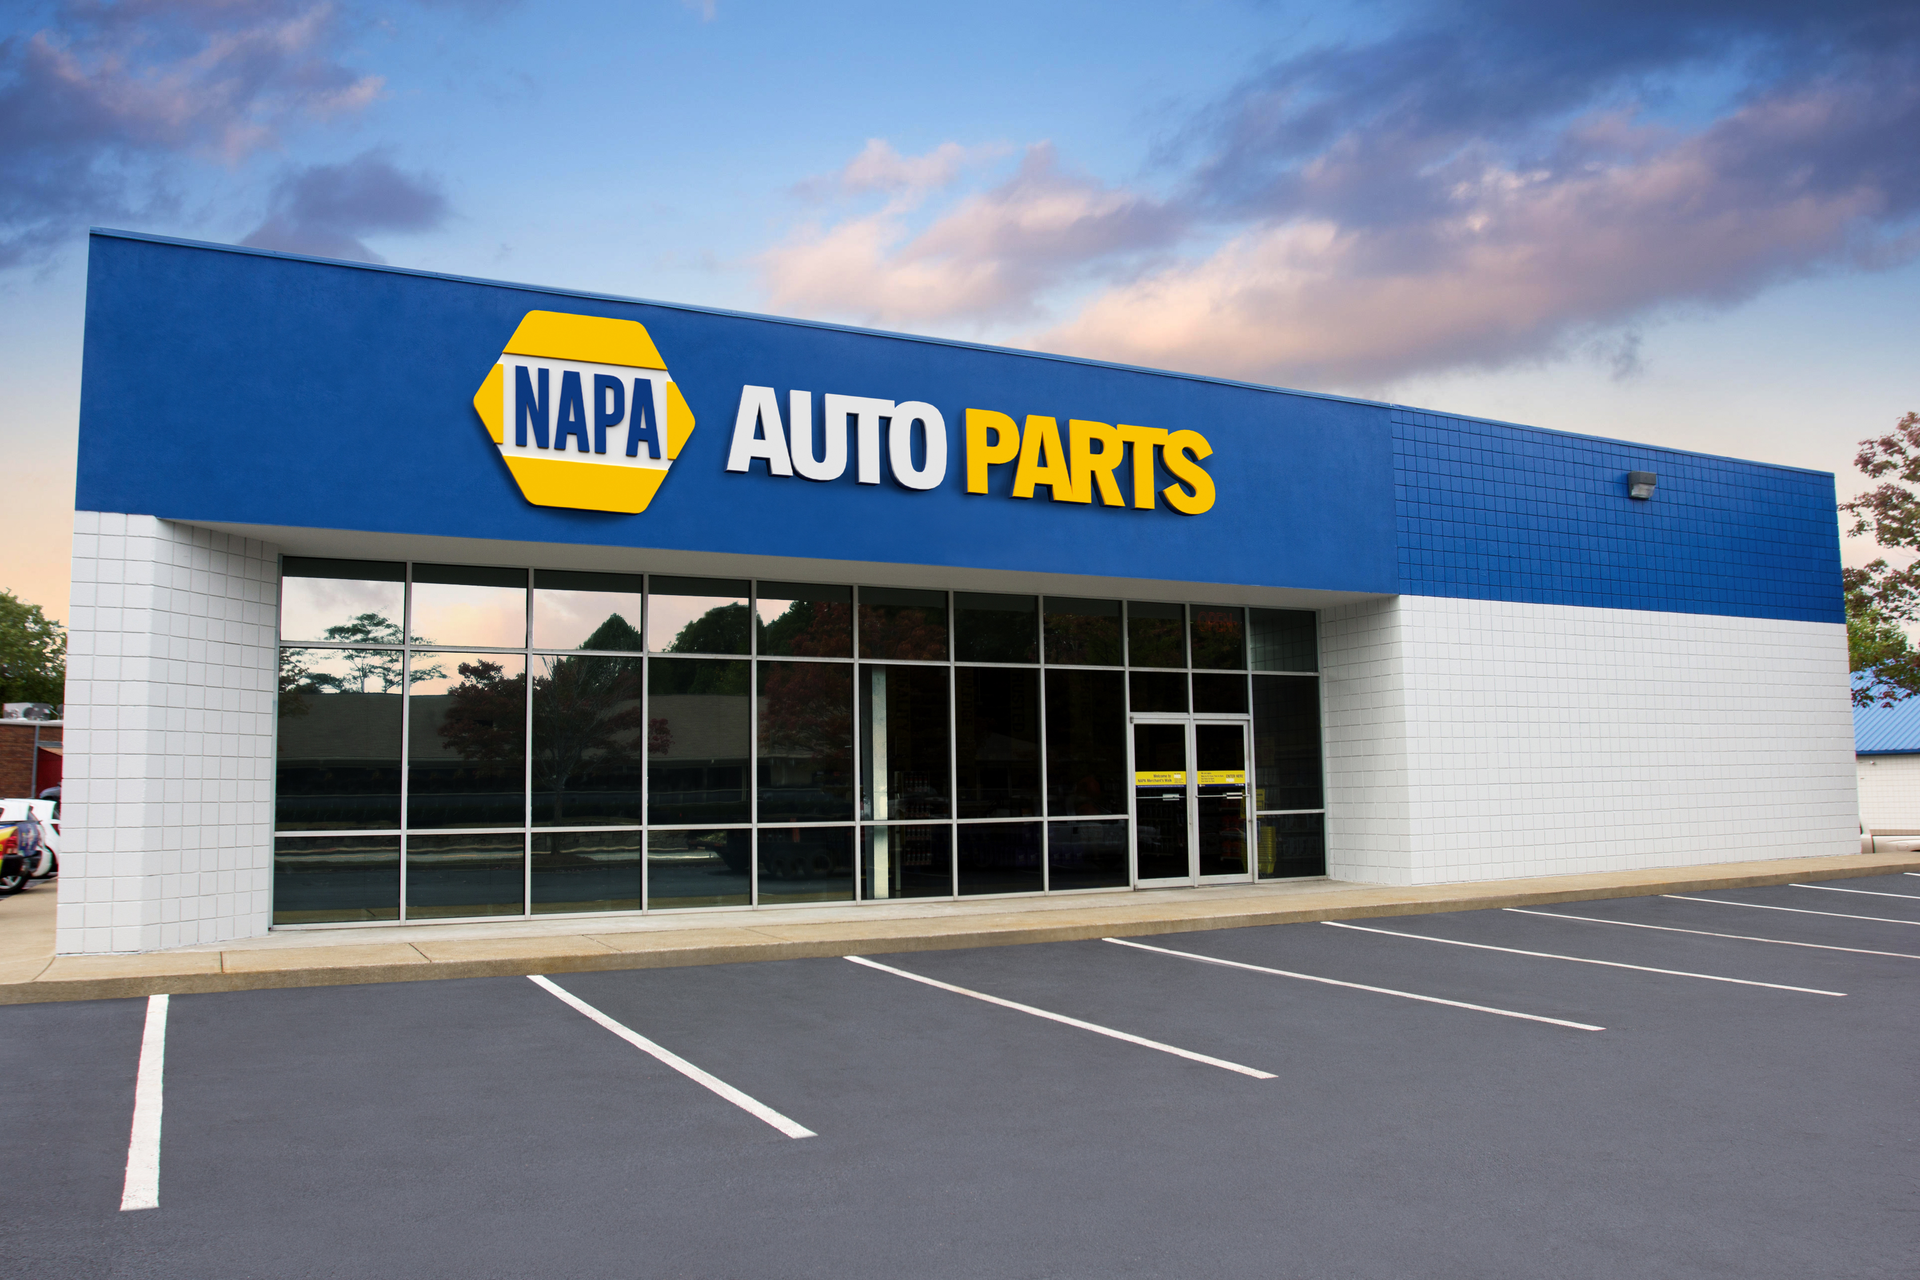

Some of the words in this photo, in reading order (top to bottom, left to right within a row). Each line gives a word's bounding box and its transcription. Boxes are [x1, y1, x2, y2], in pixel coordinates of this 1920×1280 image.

[515, 365, 661, 460] NAPA
[725, 384, 948, 490] AUTO
[963, 408, 1216, 515] PARTS
[1197, 611, 1233, 632] OPEN
[961, 669, 974, 727] WLEDGE
